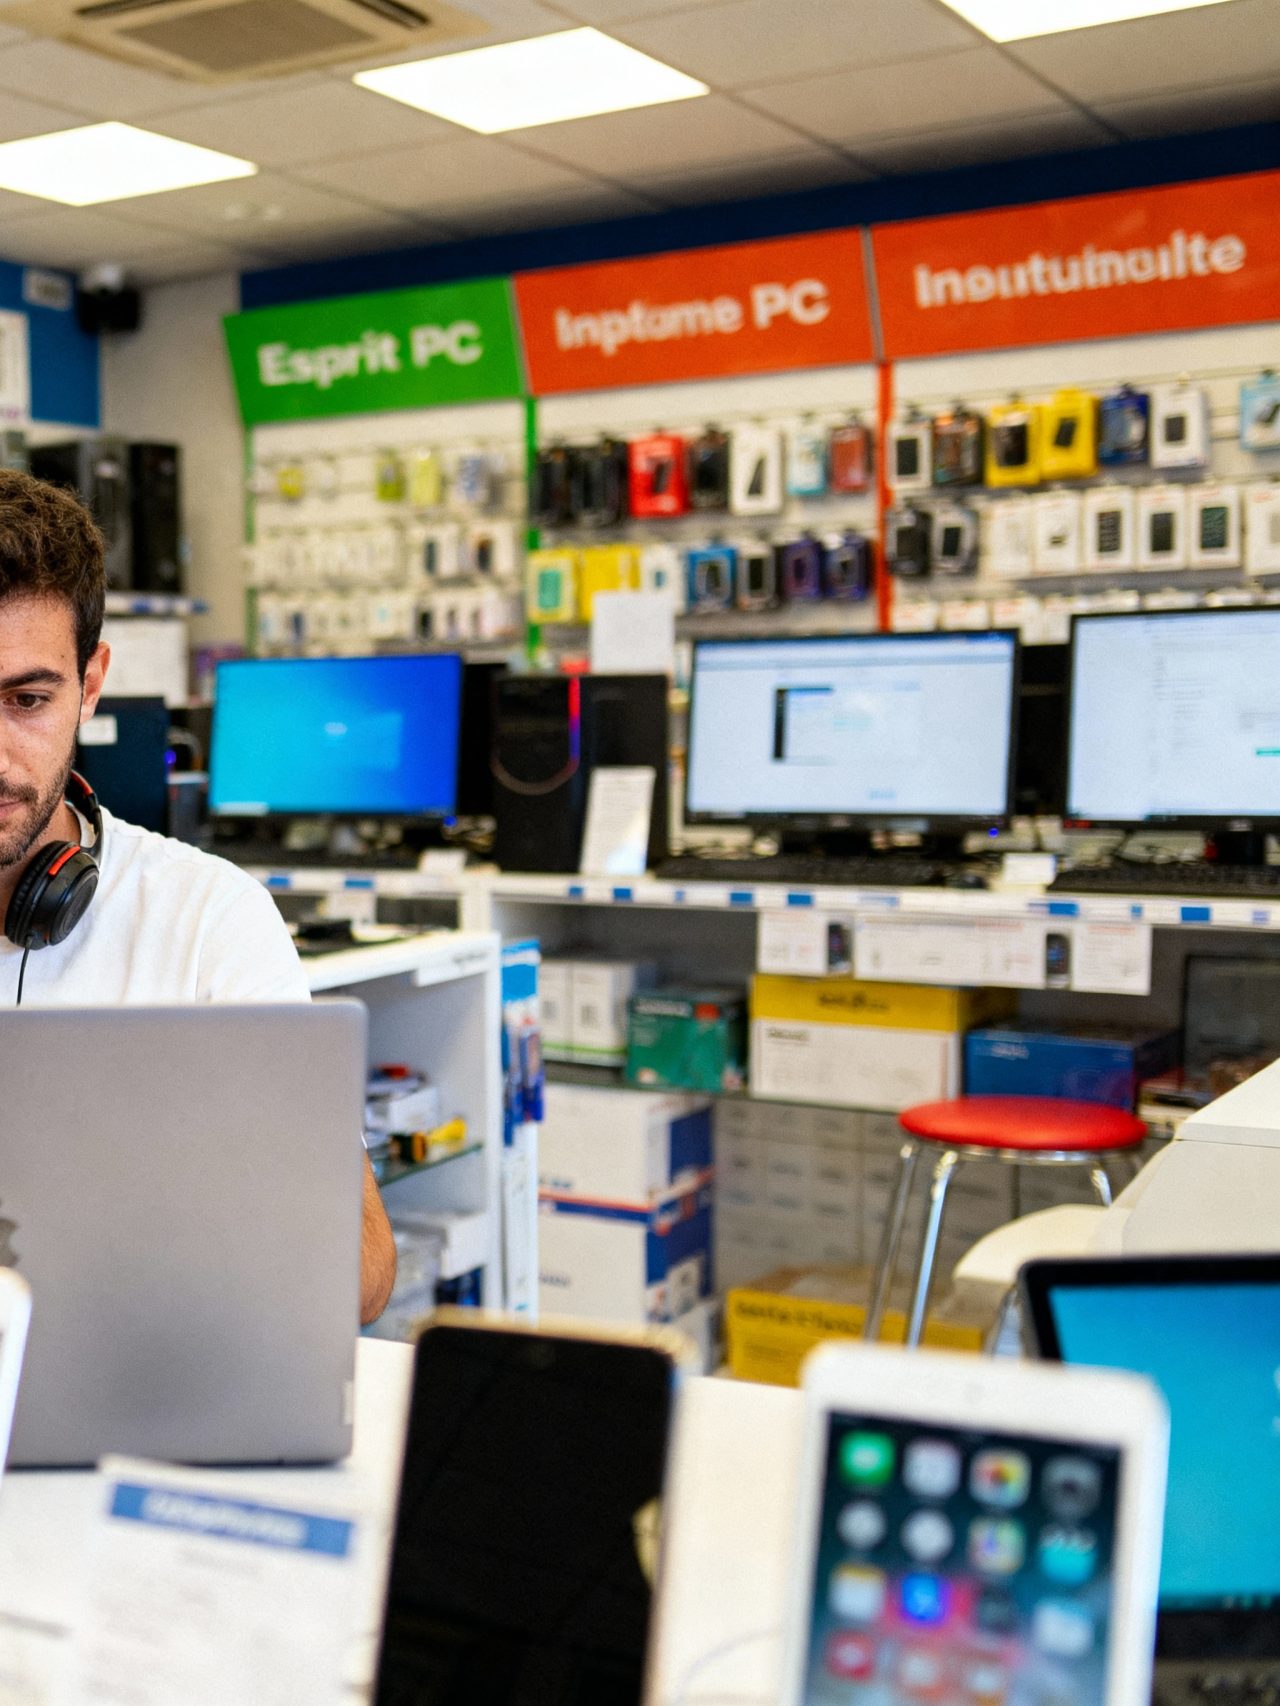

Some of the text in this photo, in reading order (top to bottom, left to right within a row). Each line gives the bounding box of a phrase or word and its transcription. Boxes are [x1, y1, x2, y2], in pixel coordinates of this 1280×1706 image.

[751, 278, 830, 329] PC
[257, 320, 483, 388] Esprit PC
